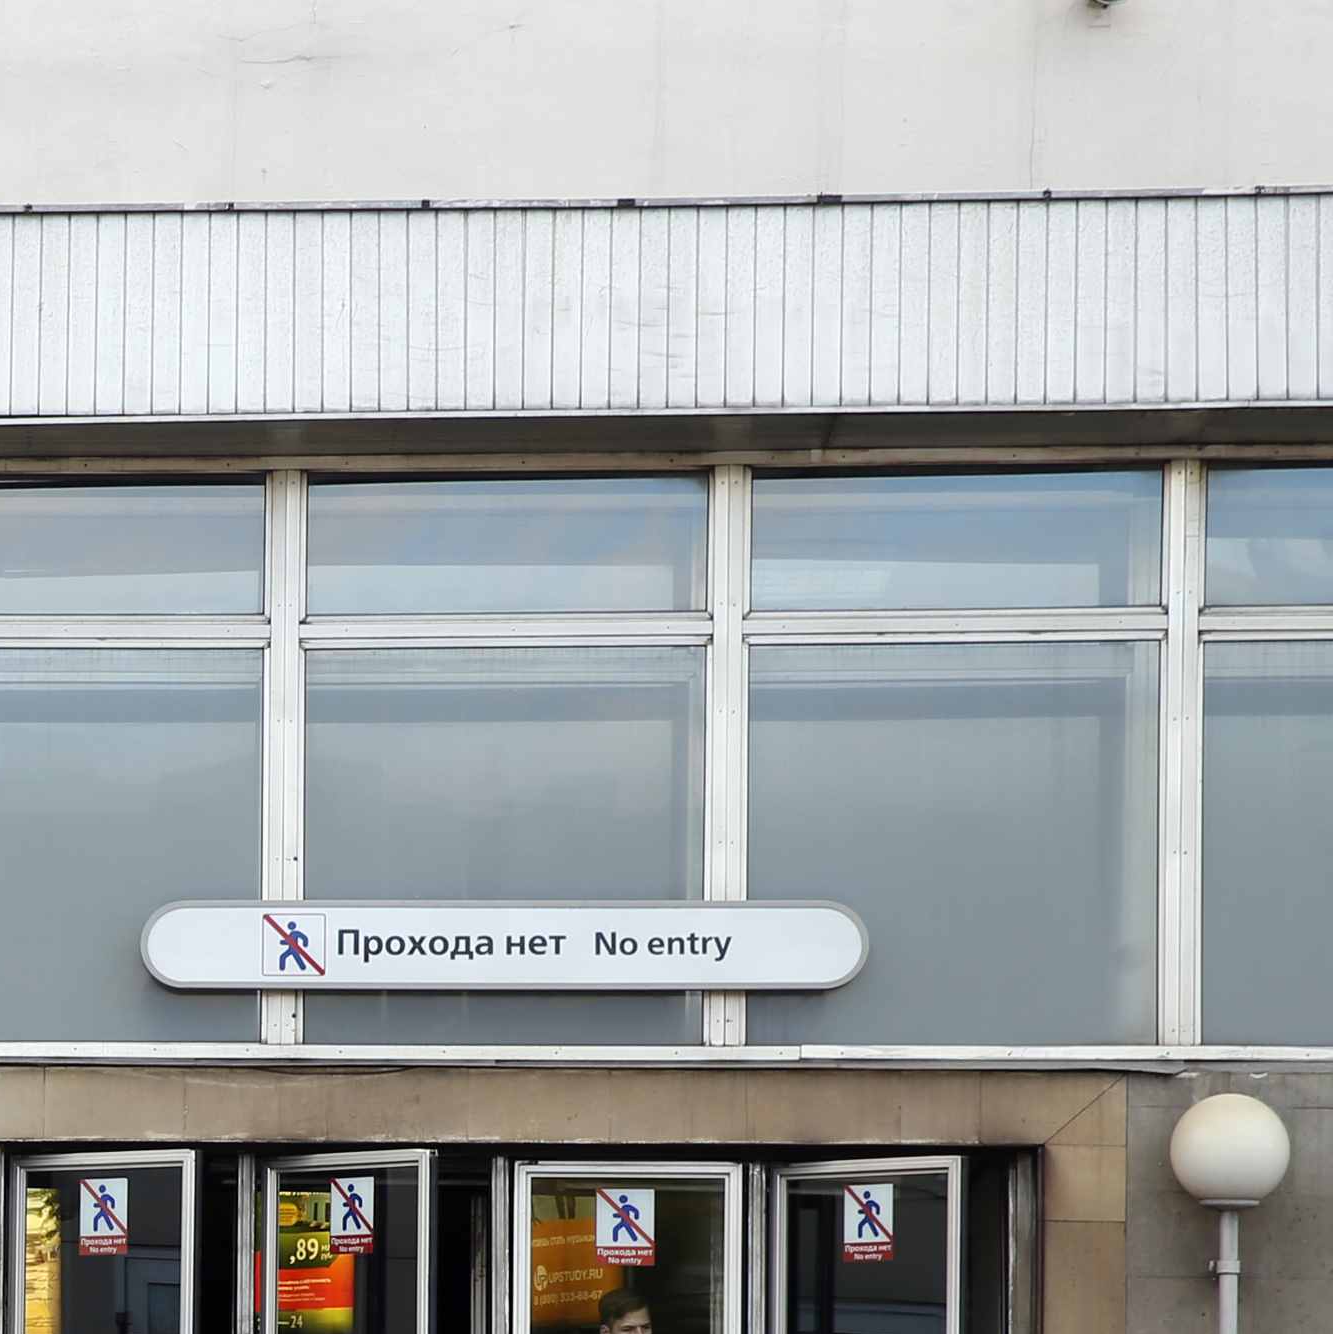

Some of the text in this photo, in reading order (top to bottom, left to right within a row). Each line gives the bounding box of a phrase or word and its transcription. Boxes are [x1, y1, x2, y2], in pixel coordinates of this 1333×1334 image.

[337, 928, 567, 963] Прохода нет
[595, 931, 733, 962] No entry
[597, 1247, 653, 1257] Прохода нет
[620, 1256, 643, 1265] entry
